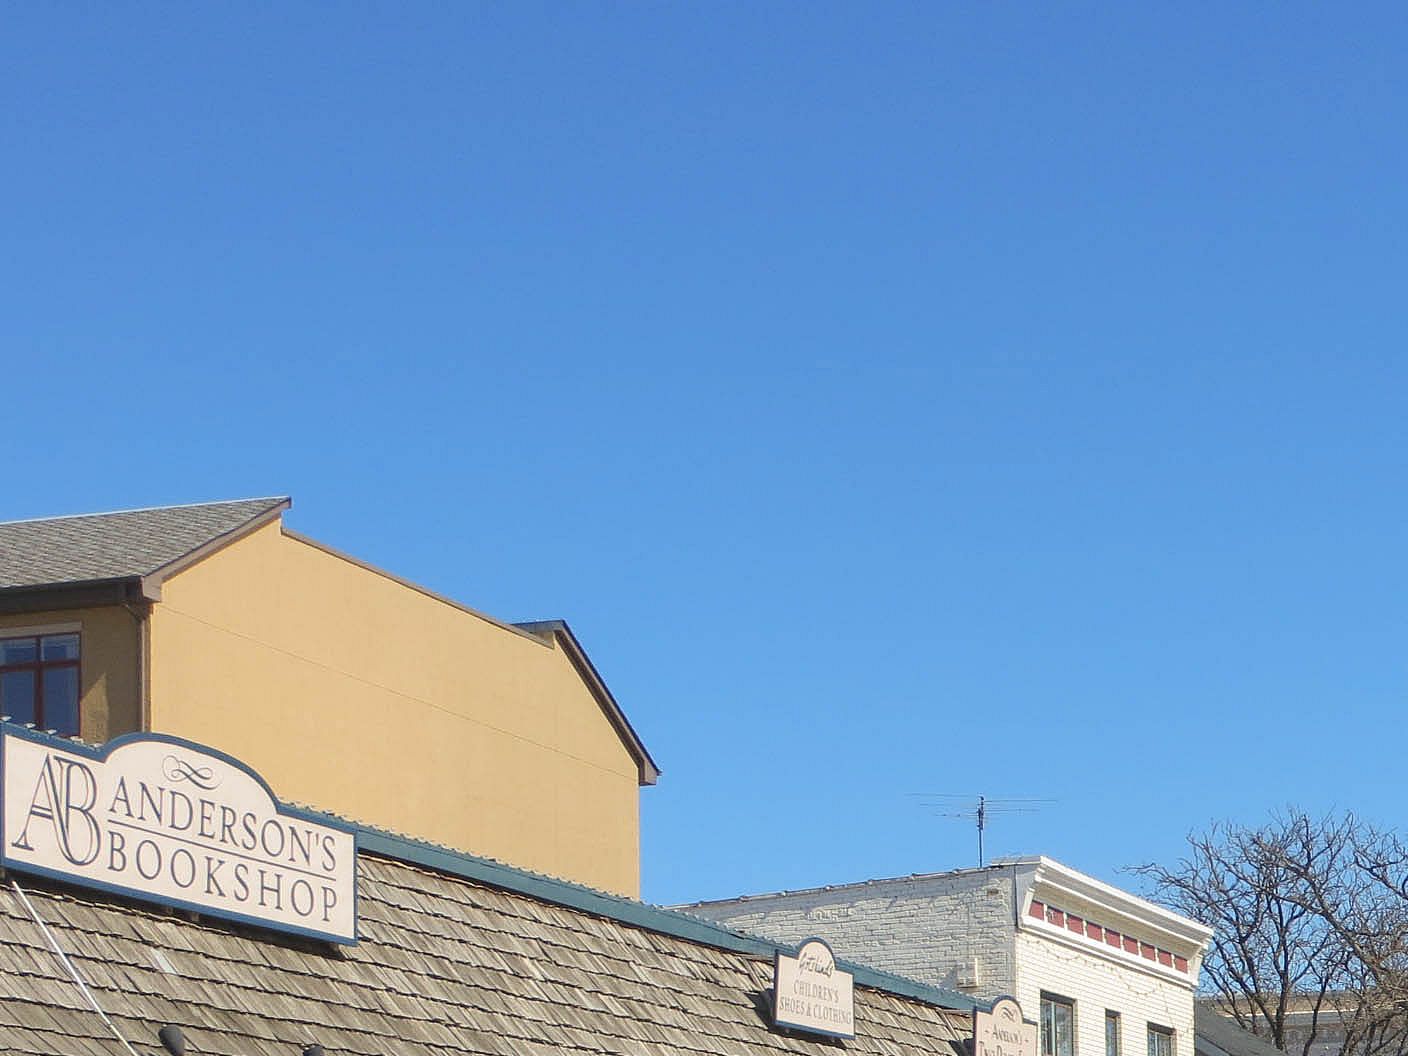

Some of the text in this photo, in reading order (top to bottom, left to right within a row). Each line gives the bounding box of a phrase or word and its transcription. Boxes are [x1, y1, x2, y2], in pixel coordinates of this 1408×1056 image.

[11, 753, 101, 866] AB
[109, 776, 338, 873] ANDERSON'S
[107, 830, 338, 922] BOOKSHOP
[779, 996, 805, 1015] SHOES
[813, 1004, 852, 1025] CLOTHING
[793, 980, 839, 1003] CHILDREN'S
